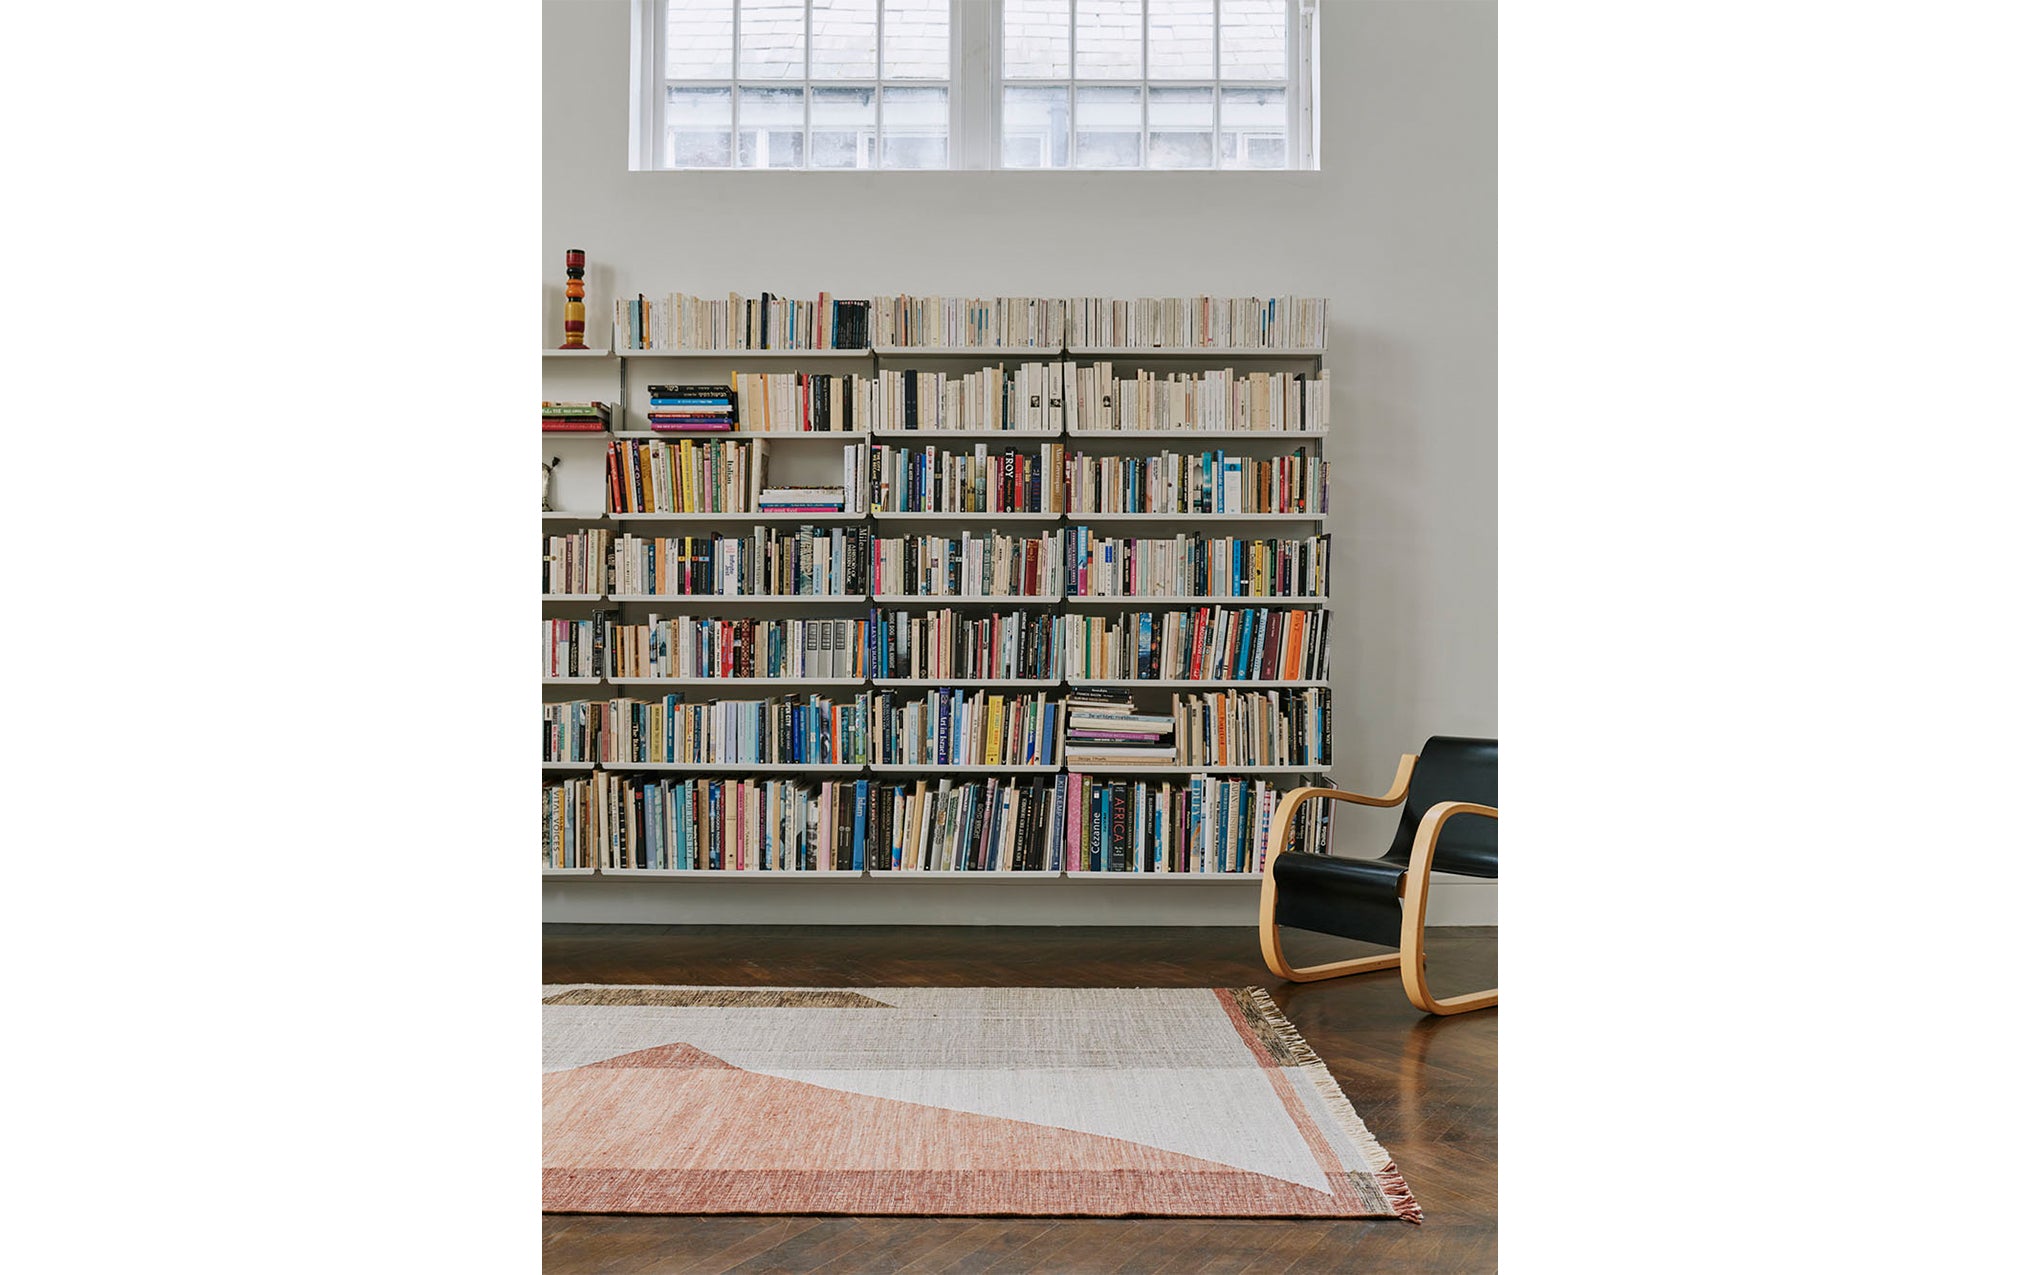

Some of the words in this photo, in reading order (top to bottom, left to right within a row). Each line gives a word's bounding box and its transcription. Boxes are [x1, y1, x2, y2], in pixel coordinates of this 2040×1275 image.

[1005, 450, 1014, 478] TROY
[859, 528, 867, 551] Miles
[1197, 626, 1205, 655] MOSCOW
[939, 735, 947, 756] Israel
[1191, 787, 1200, 816] DUFY
[1231, 782, 1240, 803] JAPAN
[857, 797, 866, 817] Islam
[1114, 797, 1125, 843] AFRICA
[1091, 812, 1101, 854] Cézanne
[1230, 809, 1238, 837] HISTORY
